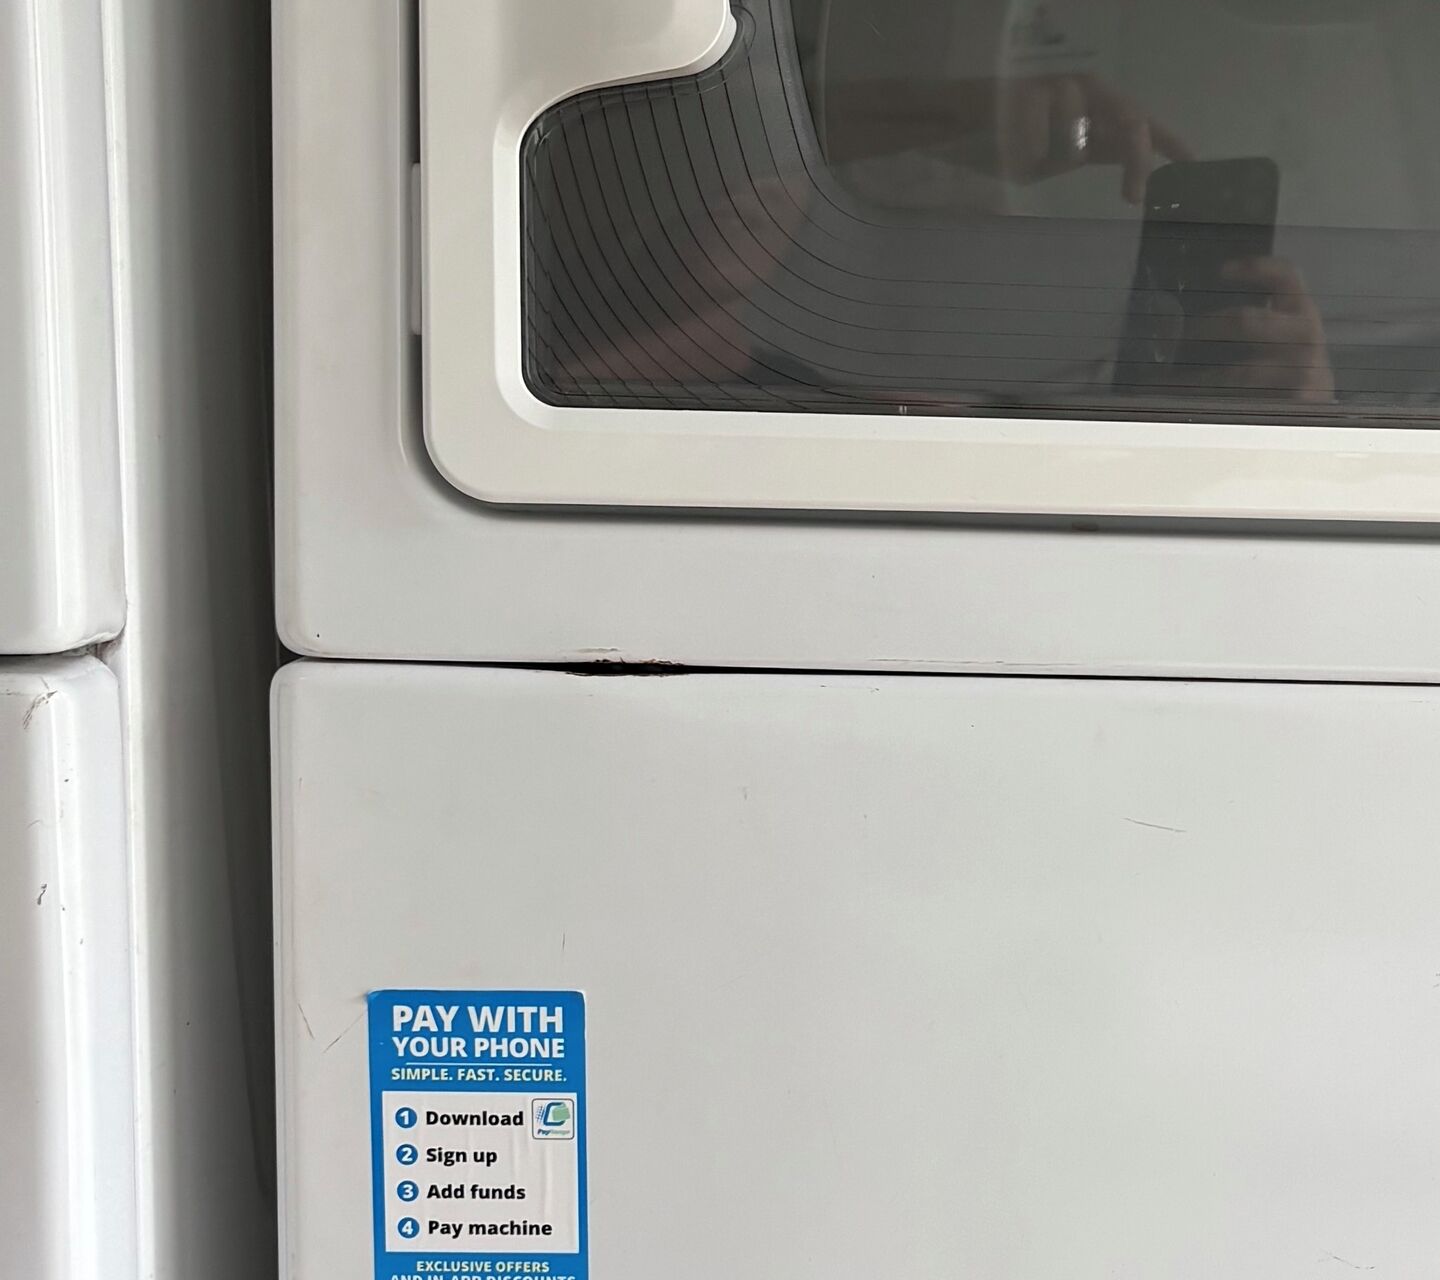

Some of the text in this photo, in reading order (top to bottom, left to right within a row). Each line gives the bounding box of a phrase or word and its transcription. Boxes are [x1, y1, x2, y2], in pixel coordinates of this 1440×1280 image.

[392, 1005, 563, 1033] PAY WITH
[392, 1037, 564, 1058] YOUR PHONE
[391, 1068, 567, 1082] SIMPLE. FAST. SECURE.
[426, 1110, 524, 1126] Download
[426, 1148, 467, 1166] Sign
[474, 1151, 497, 1167] up
[427, 1184, 464, 1199] Add
[471, 1184, 526, 1199] funds
[428, 1221, 463, 1239] Pay
[469, 1221, 552, 1236] machine
[416, 1261, 550, 1273] EXCLUSIVE OFFERS
